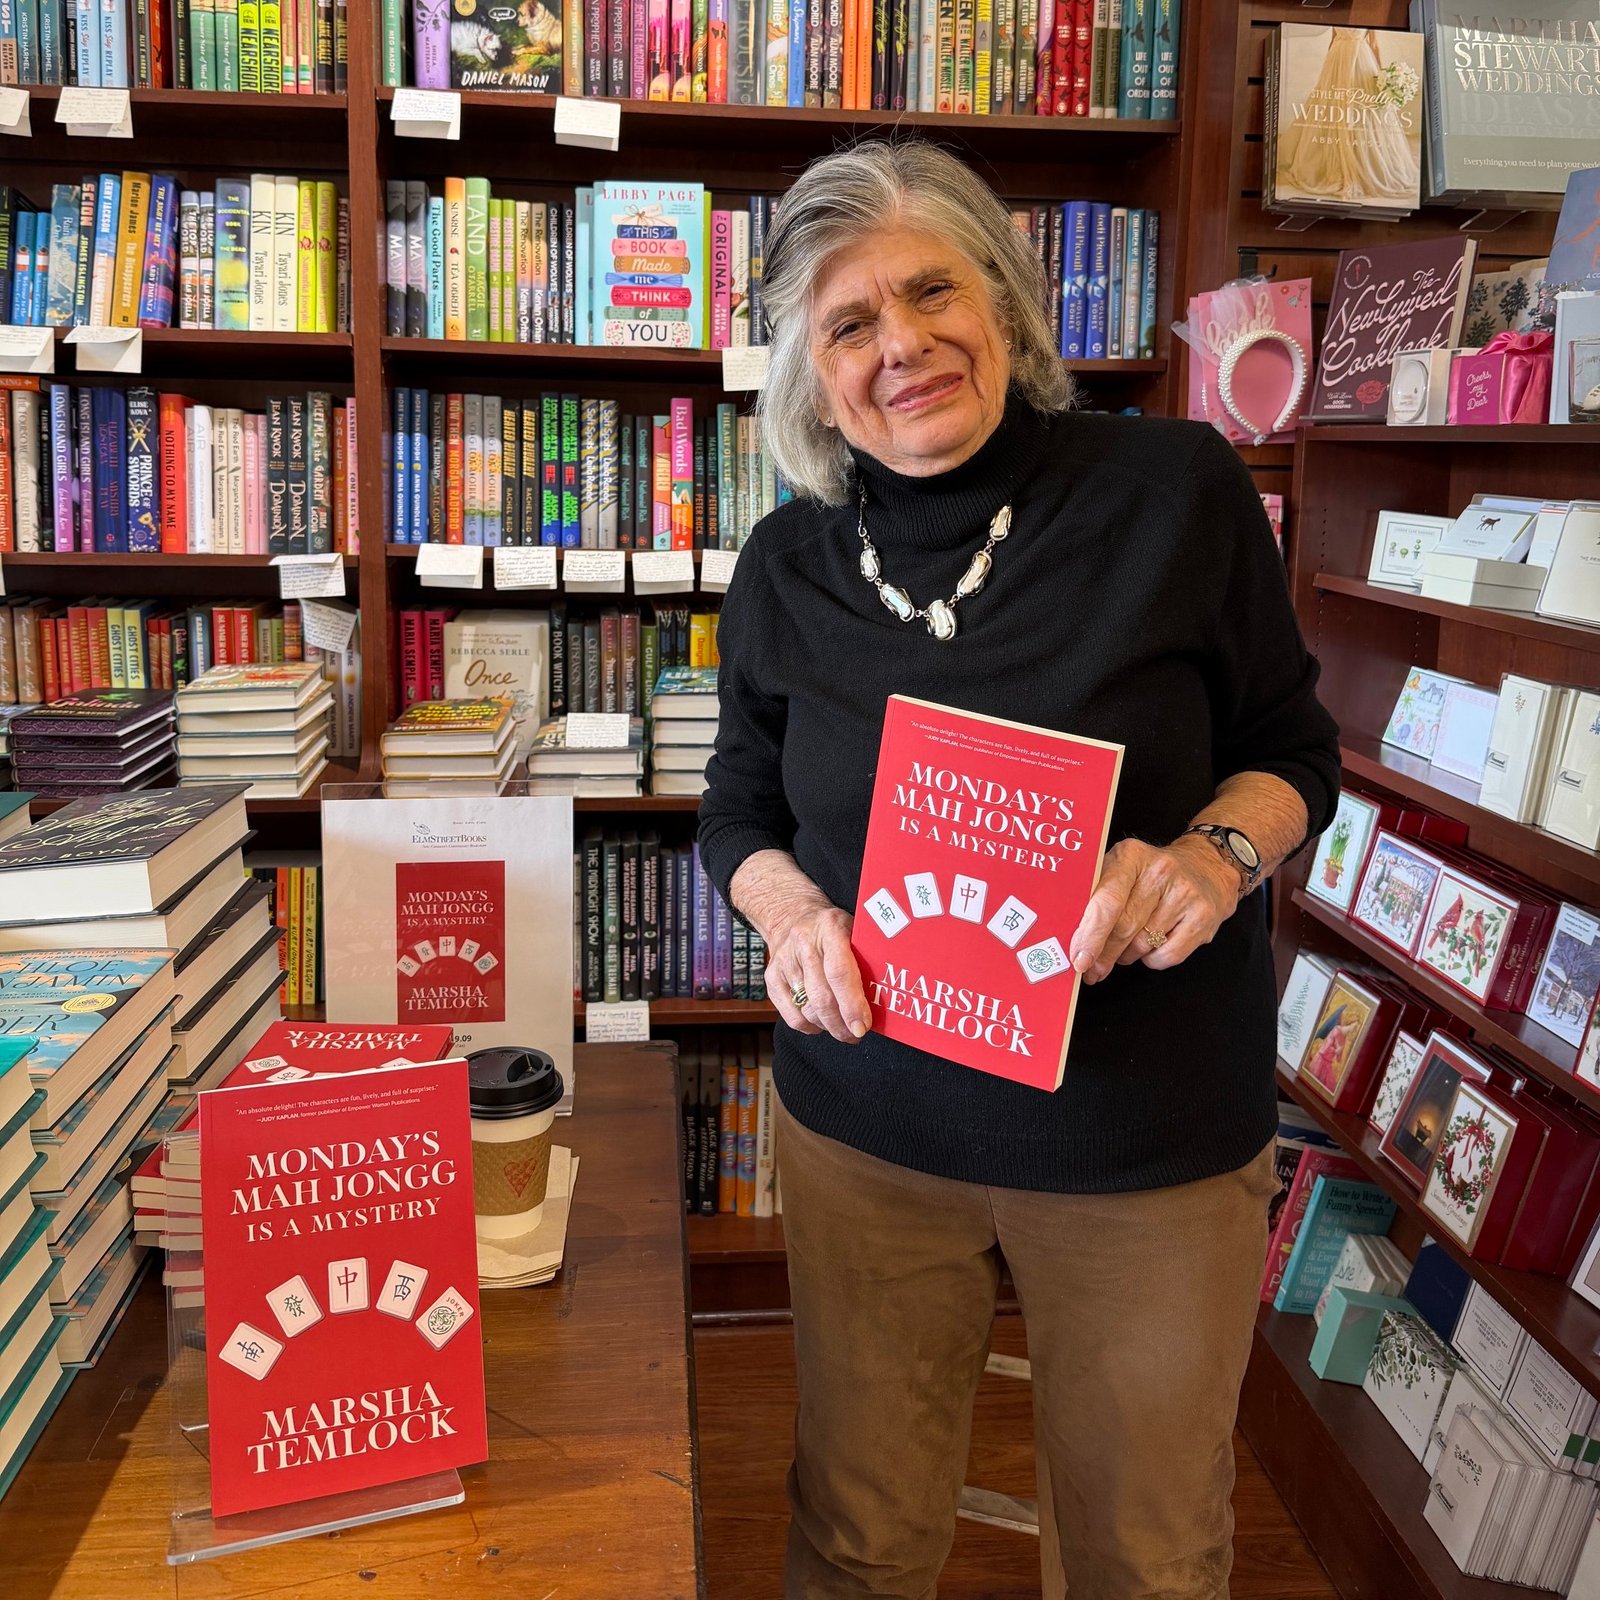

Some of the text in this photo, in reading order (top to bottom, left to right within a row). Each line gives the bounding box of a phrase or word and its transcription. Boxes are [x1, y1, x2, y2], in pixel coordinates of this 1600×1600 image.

[1454, 14, 1600, 47] MARTHA
[1132, 64, 1149, 74] OUT
[1135, 52, 1148, 62] LIFE
[1454, 42, 1600, 73] STEWART
[461, 70, 549, 88] DANIEL MASON
[1134, 77, 1146, 86] OF
[1127, 89, 1150, 98] ORDER
[1311, 89, 1332, 100] STYLE
[1332, 85, 1394, 110] Pretty
[1292, 103, 1412, 129] WEDDINGS
[1312, 136, 1340, 145] ABBY
[1463, 157, 1502, 168] Everything
[1504, 160, 1518, 168] you
[1519, 159, 1536, 167] need
[1538, 160, 1546, 168] to
[1547, 160, 1562, 168] plan
[602, 189, 696, 202] LIBBY PAGE
[467, 194, 486, 256] LAND
[634, 227, 660, 239] THIS
[76, 183, 95, 306] SCION JAMES ISLINGTON
[432, 206, 441, 290] The Good Parts
[630, 241, 667, 254] BOOK
[1074, 213, 1086, 272] Jodi Picoult
[252, 210, 272, 305] KIN Tayari Jones
[631, 257, 672, 272] Made
[715, 222, 726, 298] ORIGINAL
[634, 274, 654, 285] me
[1411, 267, 1441, 295] The
[632, 291, 671, 302] THINK
[1322, 255, 1466, 345] Newlywed
[639, 308, 652, 320] of
[627, 324, 668, 342] YOU
[1322, 307, 1456, 387] Cookbook
[1466, 371, 1492, 387] Cheers,
[1469, 384, 1488, 398] my
[1466, 397, 1489, 411] Dear
[676, 406, 688, 474] Bad Words
[128, 456, 140, 508] SWORDS
[140, 455, 152, 498] PRINCE
[166, 430, 176, 529] NOTHING TO MY NAME
[270, 400, 288, 540] JEAN KWOK DOMINION
[111, 624, 124, 679] GHOST CITIES
[451, 648, 529, 656] REBECCA SERLE
[552, 632, 563, 693] BOOK WITCH
[464, 659, 518, 687] Once
[1030, 750, 1040, 758] and
[907, 762, 1075, 822] MONDAY'S
[891, 784, 1084, 852] MAH JONGG
[900, 816, 1064, 873] IS A MYSTERY
[401, 902, 494, 916] MAH JONGG
[407, 890, 488, 903] MONDAY'S
[588, 848, 599, 946] THE MIDNIGHT SHOW
[960, 882, 978, 913] 中
[407, 916, 487, 926] IS A MYSTERY
[1046, 944, 1062, 967] JOKER
[406, 997, 489, 1010] TEMLOCK
[412, 986, 484, 999] MARSHA
[881, 962, 1026, 1030] MARSHA
[870, 981, 1035, 1058] TEMLOCK
[284, 1030, 423, 1042] TEMLOCK
[290, 1040, 414, 1050] MARSHA
[248, 1105, 273, 1114] absolute
[298, 1100, 308, 1108] The
[310, 1097, 338, 1107] characters
[350, 1094, 362, 1102] fun,
[362, 1091, 380, 1101] lively,
[392, 1088, 402, 1096] full
[372, 1101, 391, 1109] Woman
[246, 1130, 441, 1180] MONDAY'S
[230, 1159, 458, 1216] MAH JONGG
[1330, 1186, 1360, 1199] How to
[247, 1196, 442, 1242] IS A MYSTERY
[1326, 1199, 1352, 1214] Funny
[336, 1266, 358, 1304] 中
[445, 1296, 464, 1318] JOKER
[260, 1381, 444, 1441] MARSHA
[247, 1406, 458, 1474] TEMLOCK
